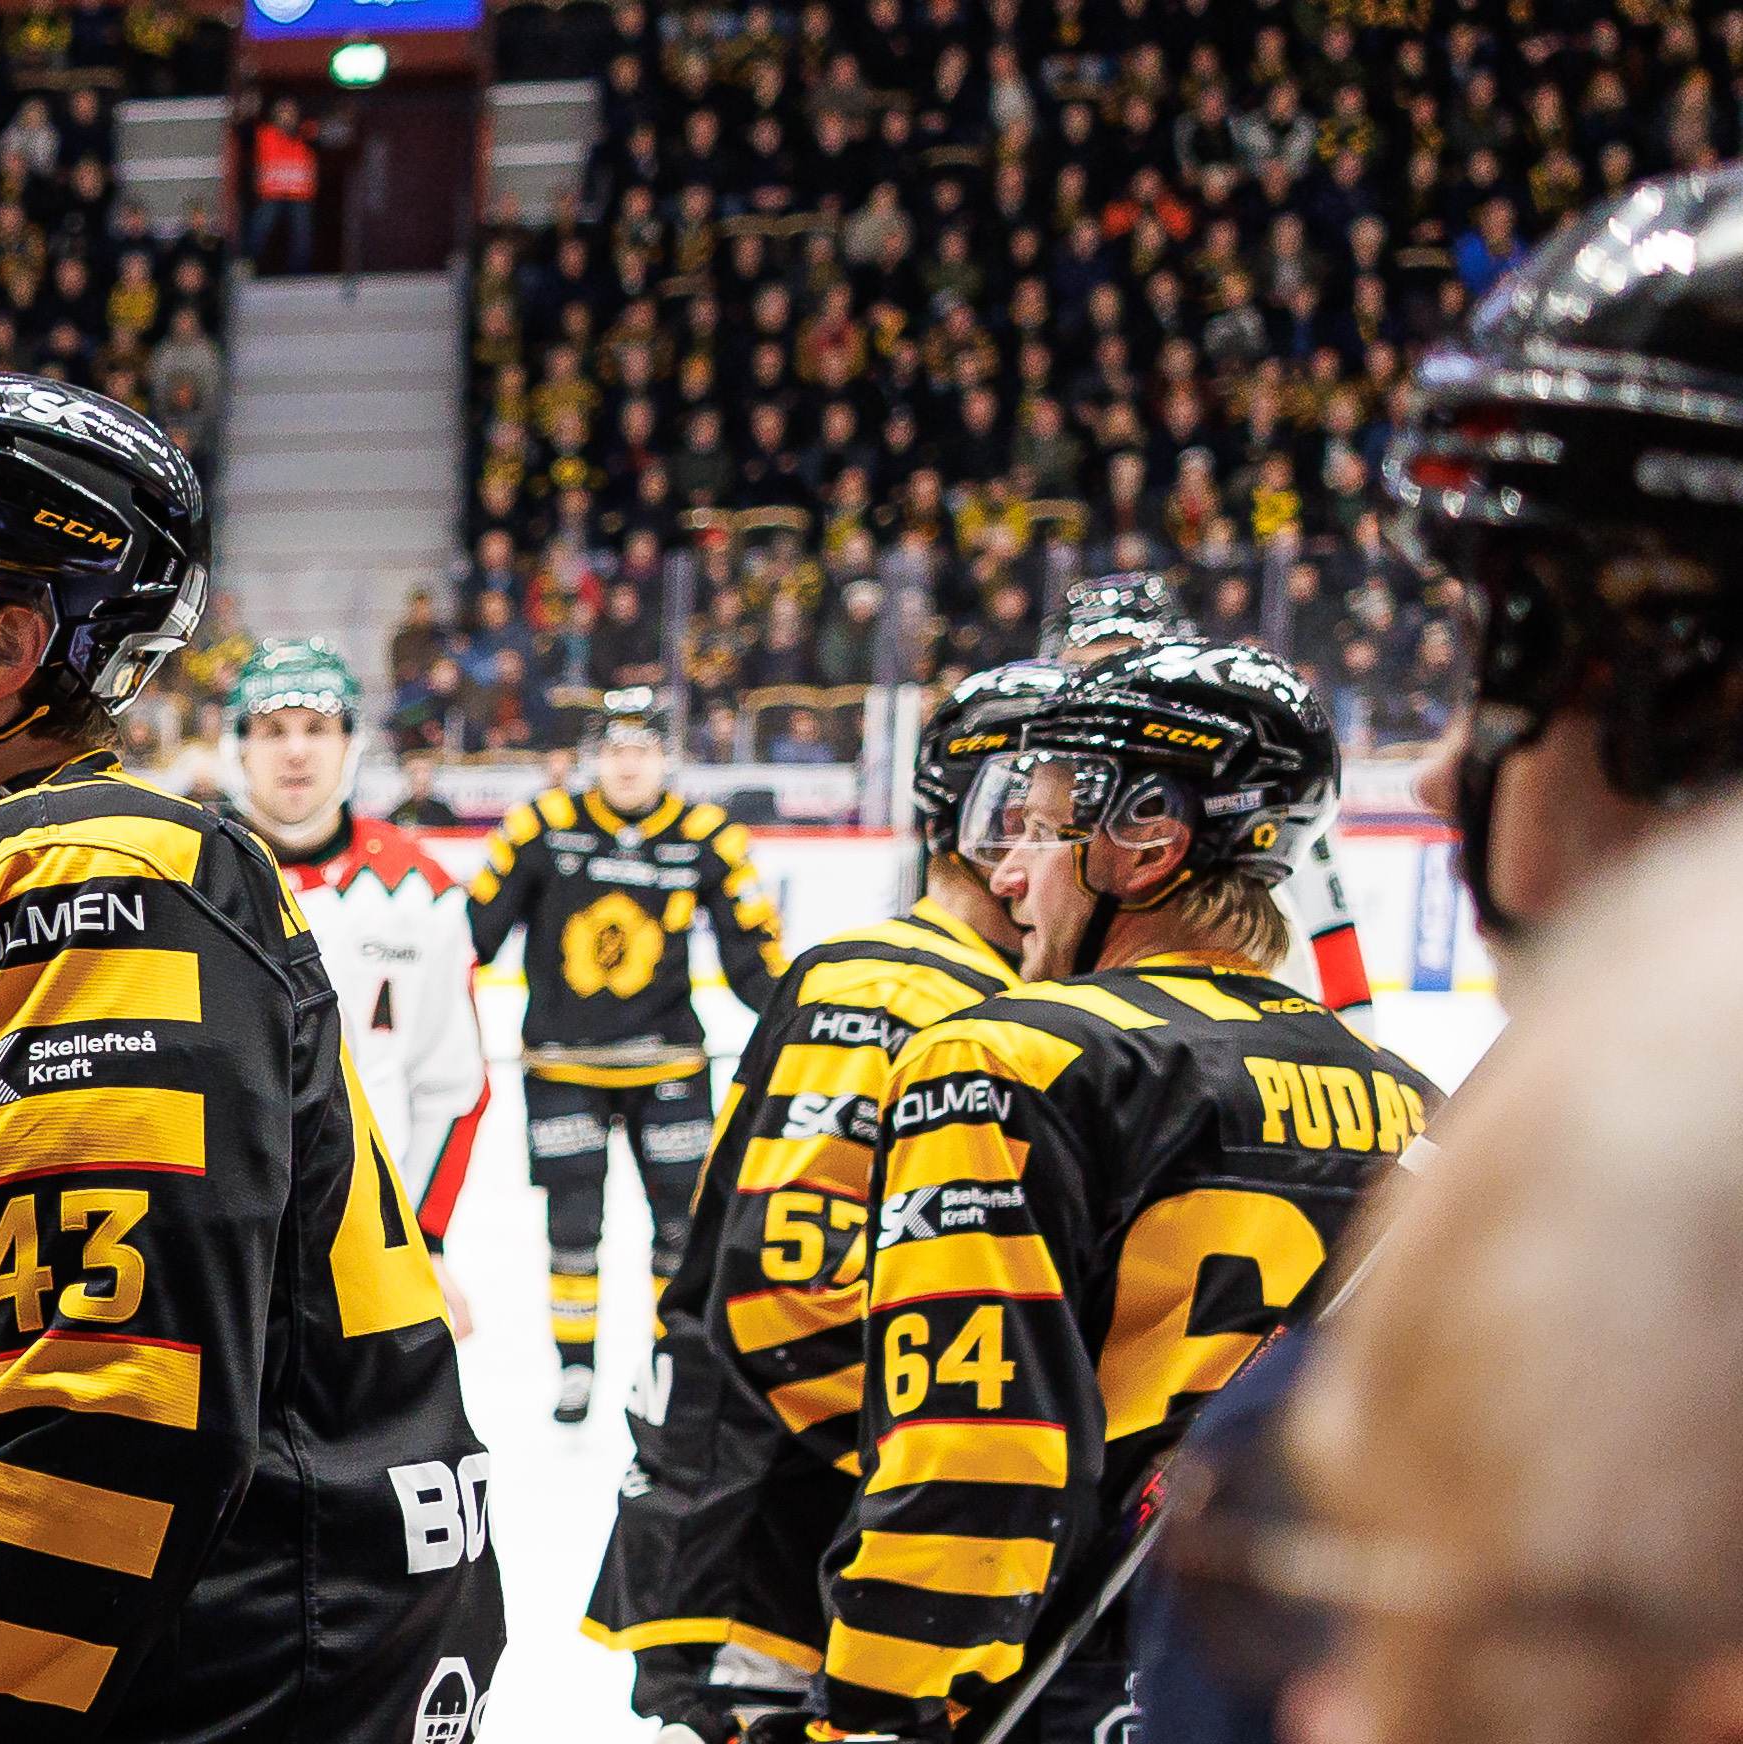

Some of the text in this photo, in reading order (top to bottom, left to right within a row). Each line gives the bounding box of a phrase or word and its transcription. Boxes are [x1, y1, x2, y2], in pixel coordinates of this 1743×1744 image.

[33, 508, 123, 551] CCM
[948, 733, 1009, 755] CCM
[1143, 722, 1223, 751] CCM
[28, 1030, 157, 1063] Skellefteå
[27, 1058, 93, 1086] Kraft
[876, 1184, 941, 1249] SK
[940, 1207, 986, 1228] Kraft
[760, 1190, 869, 1284] 57
[883, 1304, 1015, 1418] 64
